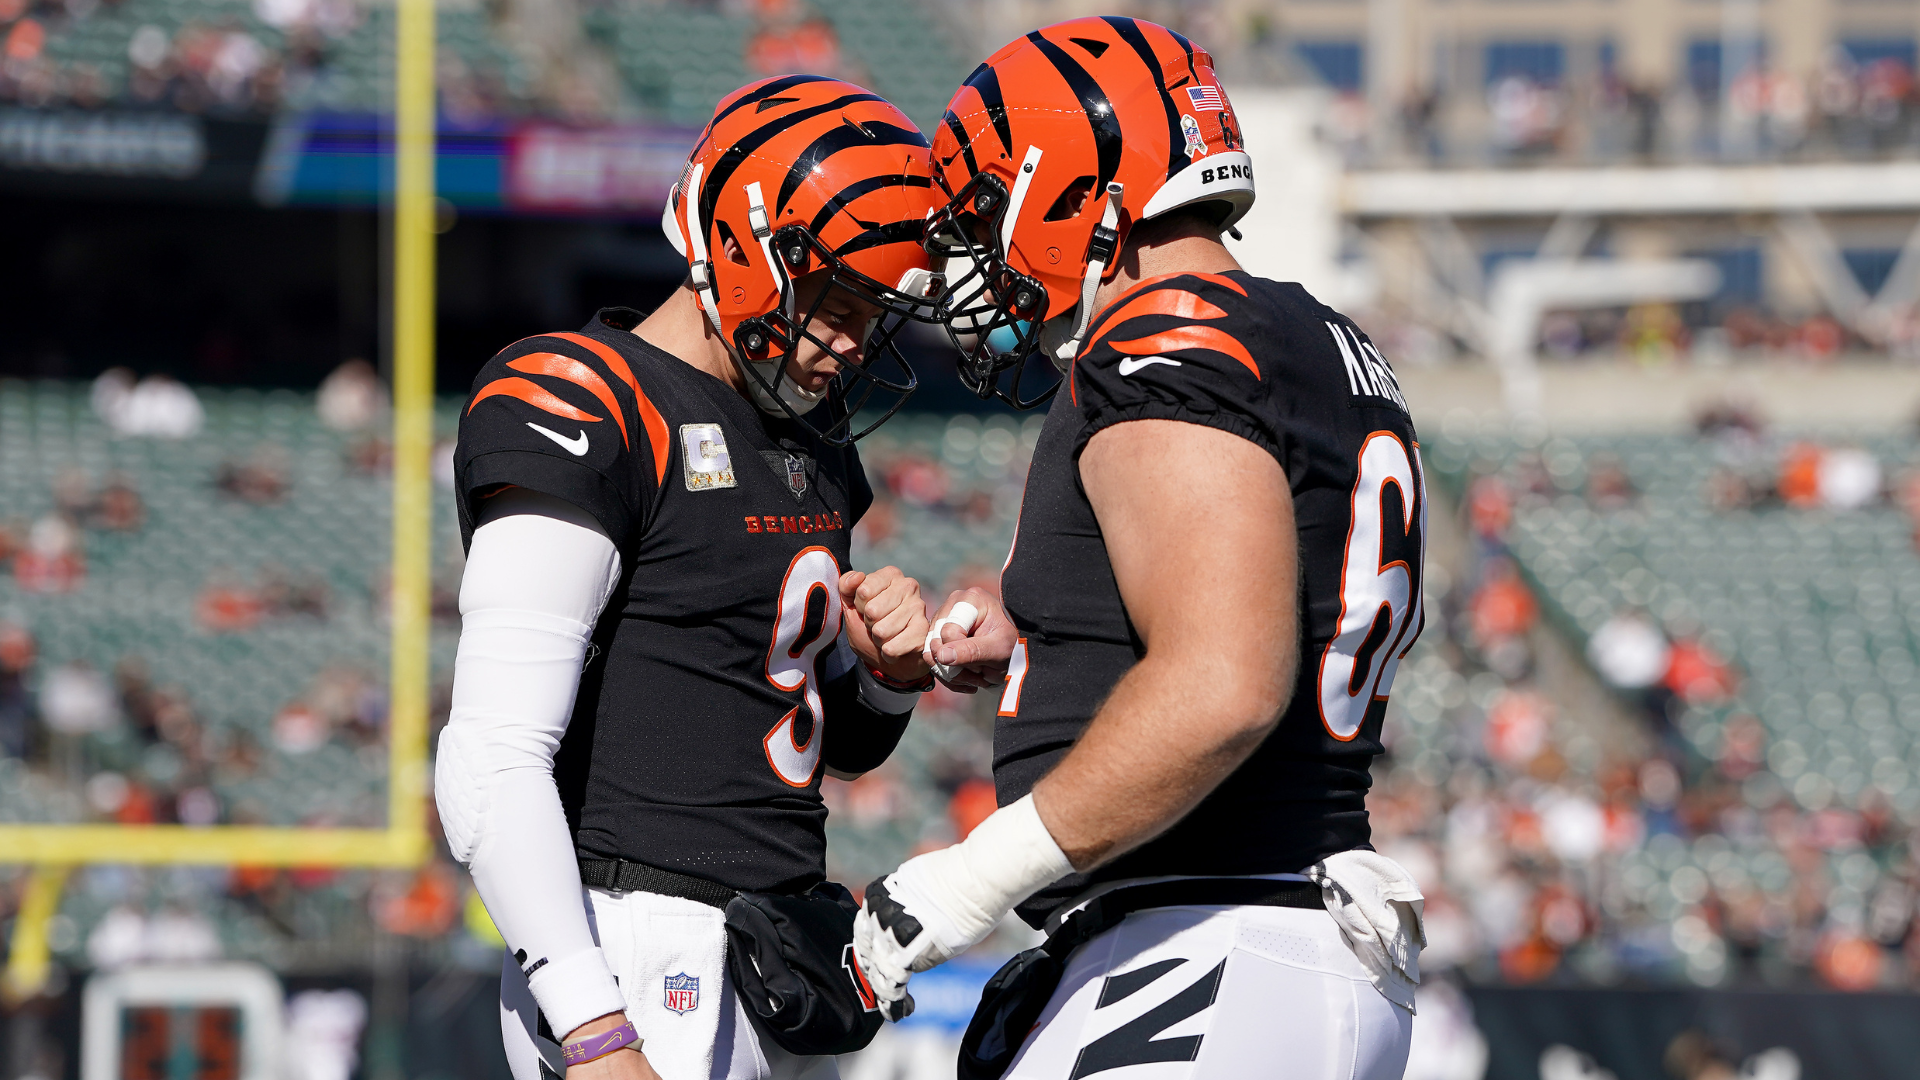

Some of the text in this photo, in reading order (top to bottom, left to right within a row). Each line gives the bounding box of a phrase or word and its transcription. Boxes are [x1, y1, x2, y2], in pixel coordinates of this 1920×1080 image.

[1187, 134, 1201, 145] NFL
[687, 428, 729, 473] C
[791, 473, 805, 489] NFL
[745, 511, 843, 534] BENGALS
[763, 545, 842, 787] 9
[668, 990, 697, 1010] NFL
